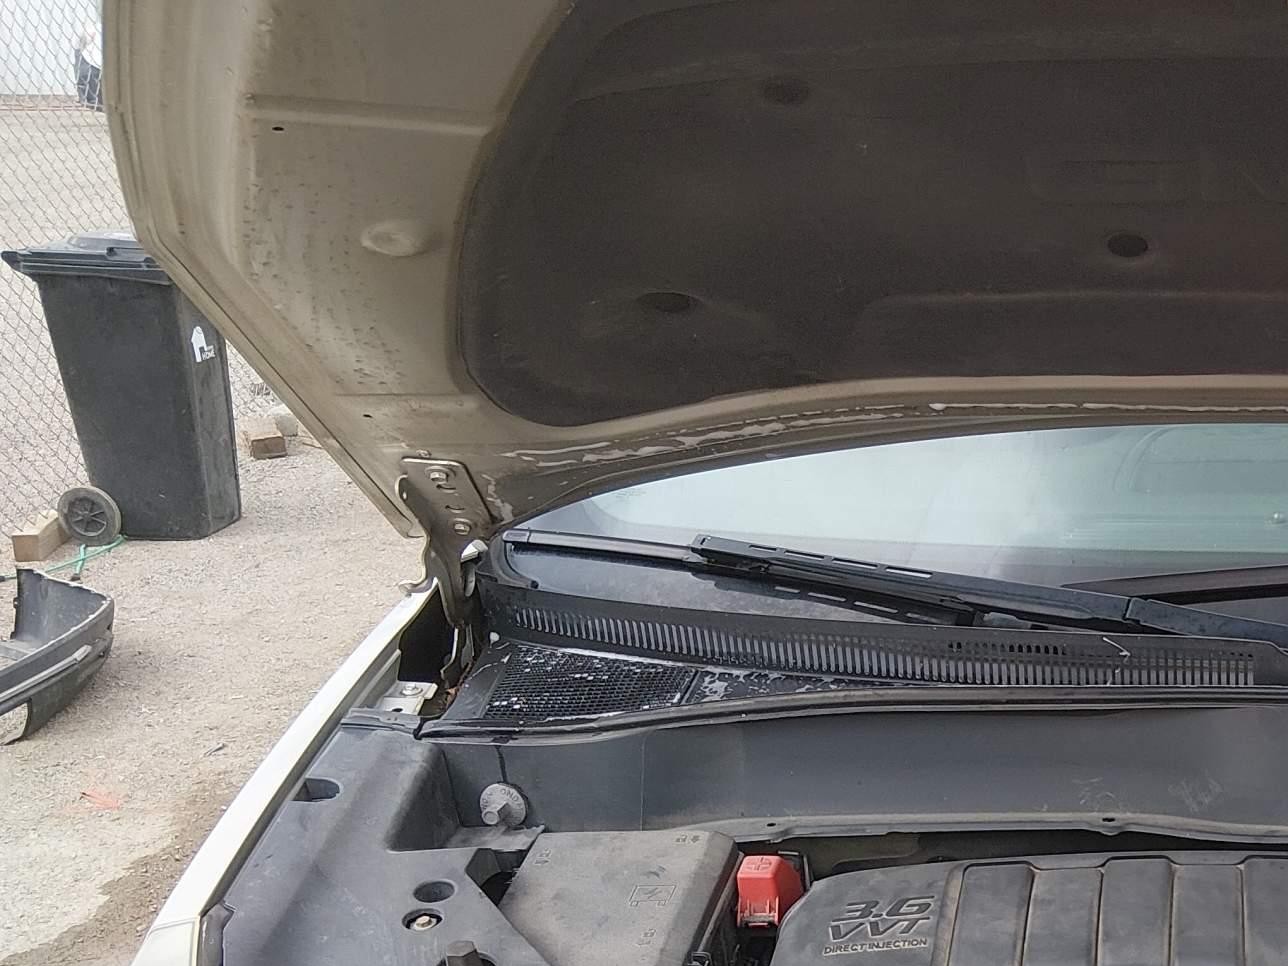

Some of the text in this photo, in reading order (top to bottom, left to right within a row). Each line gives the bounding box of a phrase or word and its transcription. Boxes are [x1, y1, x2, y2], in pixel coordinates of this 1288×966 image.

[832, 896, 935, 922] 3.6
[829, 917, 931, 943] VVT
[824, 939, 928, 956] DIRECT INJECTION
